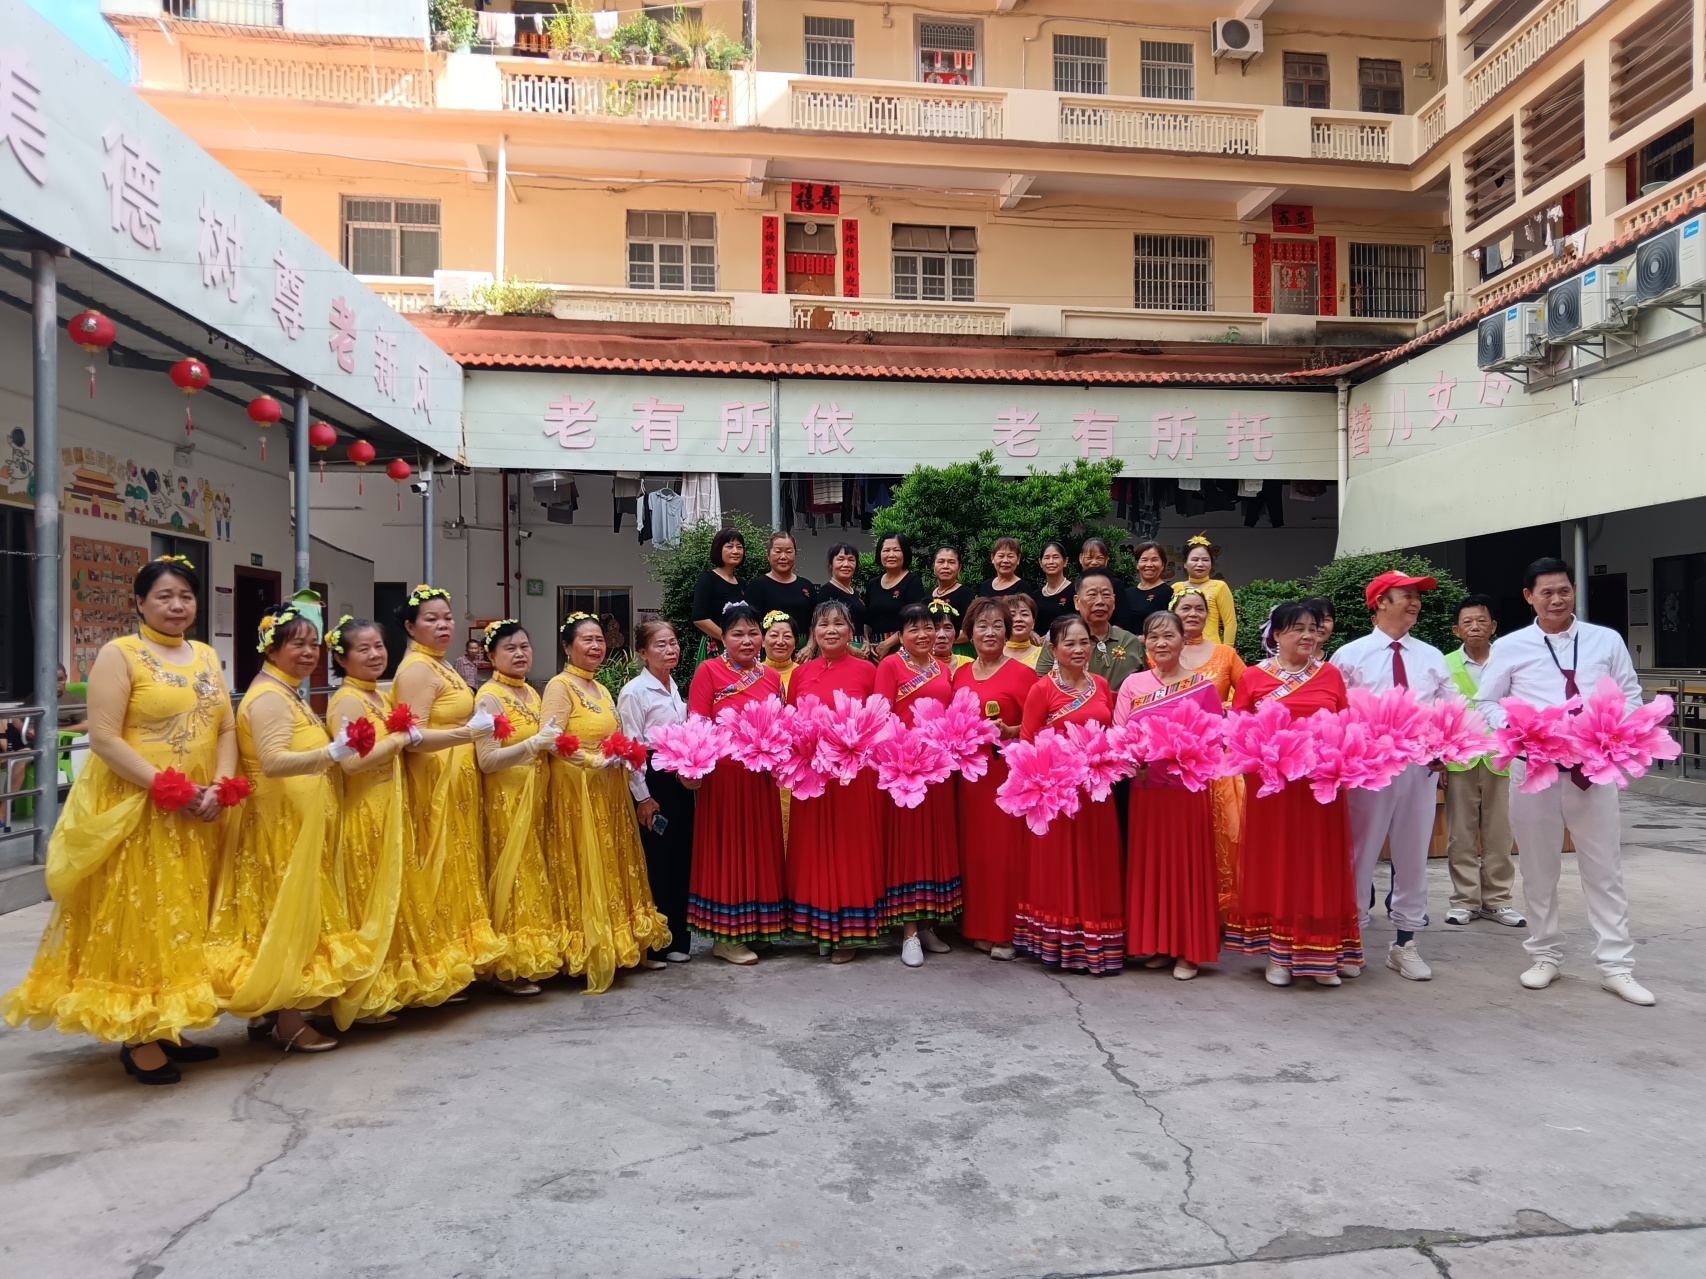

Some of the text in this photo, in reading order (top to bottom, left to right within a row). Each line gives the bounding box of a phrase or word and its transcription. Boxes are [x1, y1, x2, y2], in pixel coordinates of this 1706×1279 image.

[543, 393, 1273, 461] 老有所依 老有所托
